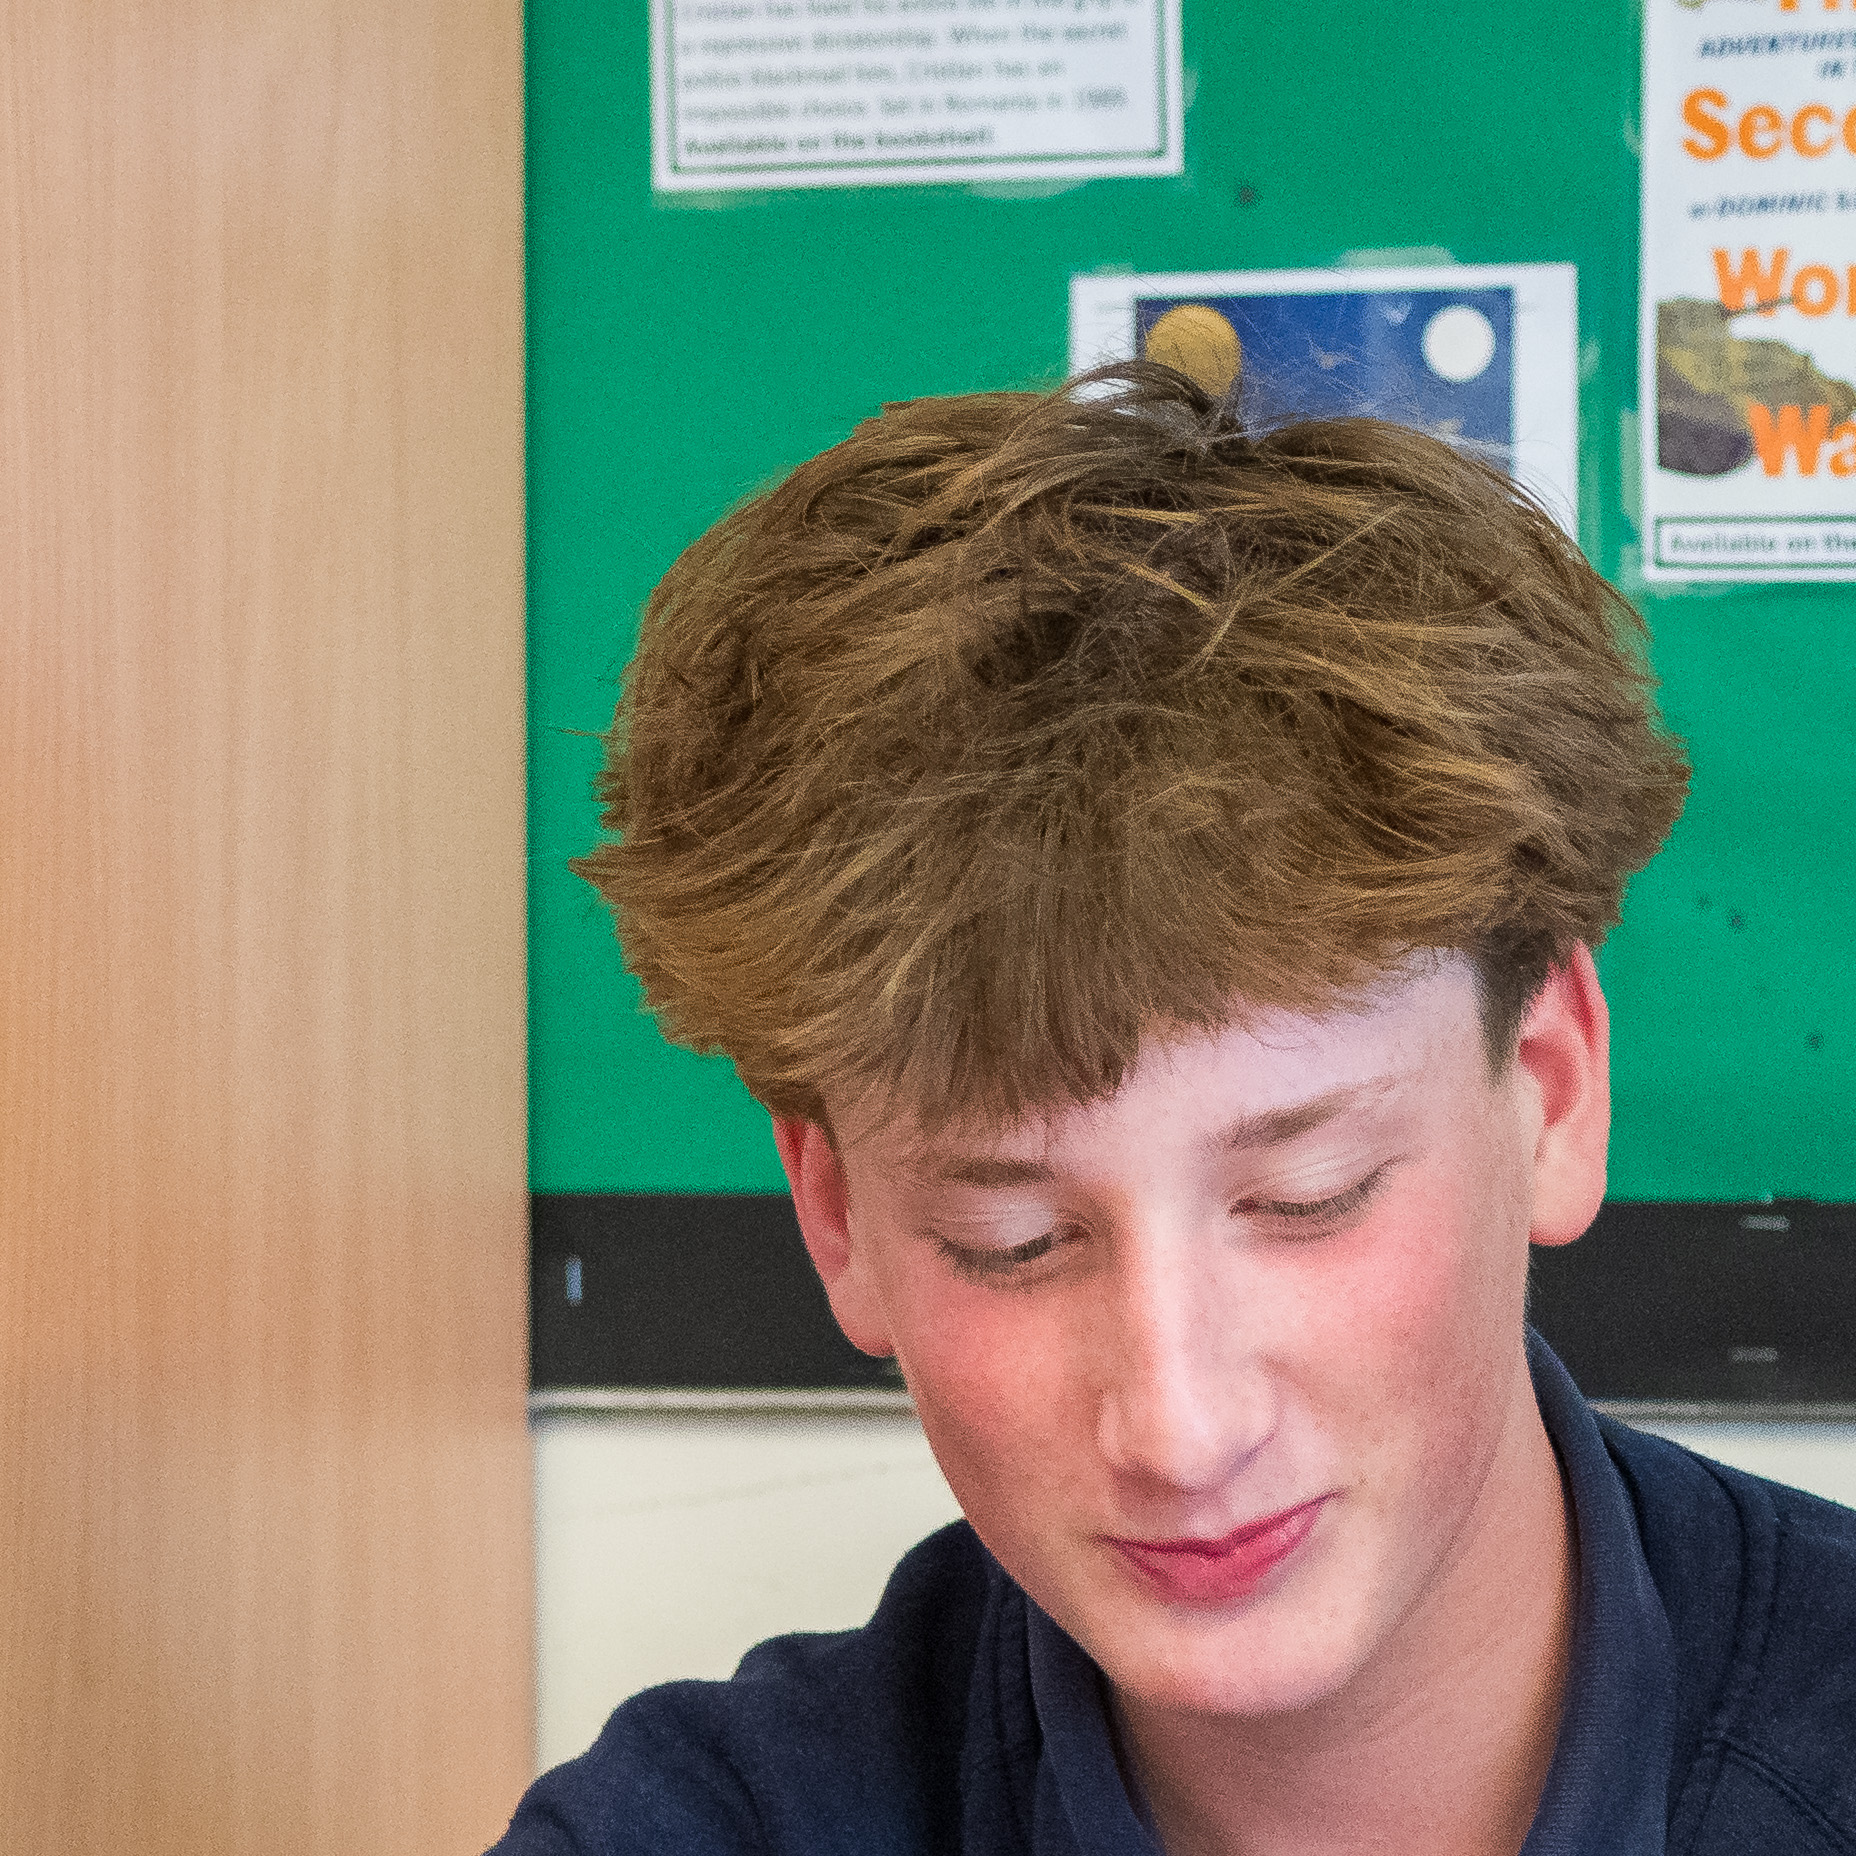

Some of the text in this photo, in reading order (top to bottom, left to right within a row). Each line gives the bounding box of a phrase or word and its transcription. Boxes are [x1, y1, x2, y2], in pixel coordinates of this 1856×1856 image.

[1715, 190, 1829, 218] DOMINIC
[1670, 532, 1778, 556] Available
[1787, 534, 1818, 551] on
